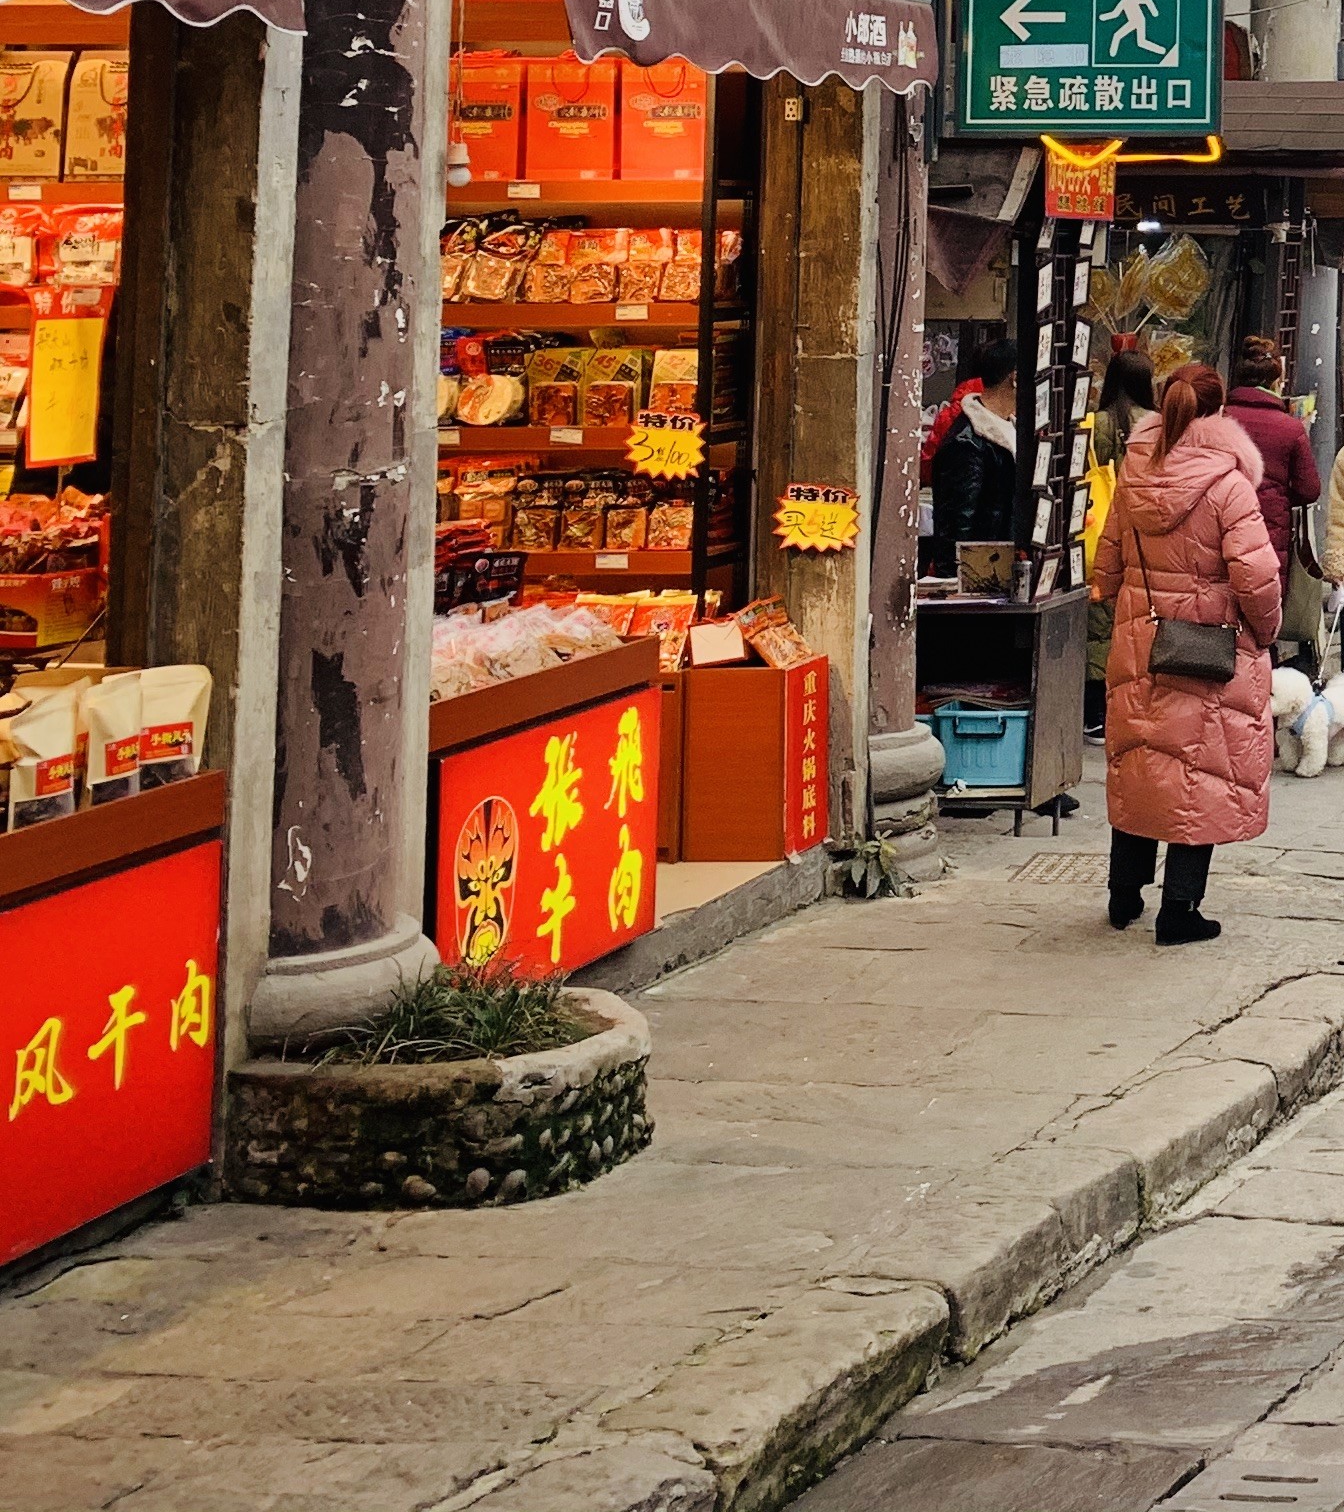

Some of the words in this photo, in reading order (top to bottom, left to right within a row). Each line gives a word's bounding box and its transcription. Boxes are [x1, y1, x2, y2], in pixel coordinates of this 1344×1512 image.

[844, 10, 887, 47] 小郎酒
[989, 75, 1192, 112] 紧急疏散出口
[1115, 192, 1251, 221] 民间工艺
[638, 413, 697, 430] 特价
[789, 487, 850, 504] 特价
[801, 670, 818, 840] 重庆火锅底料
[7, 959, 213, 1117] 风干肉
